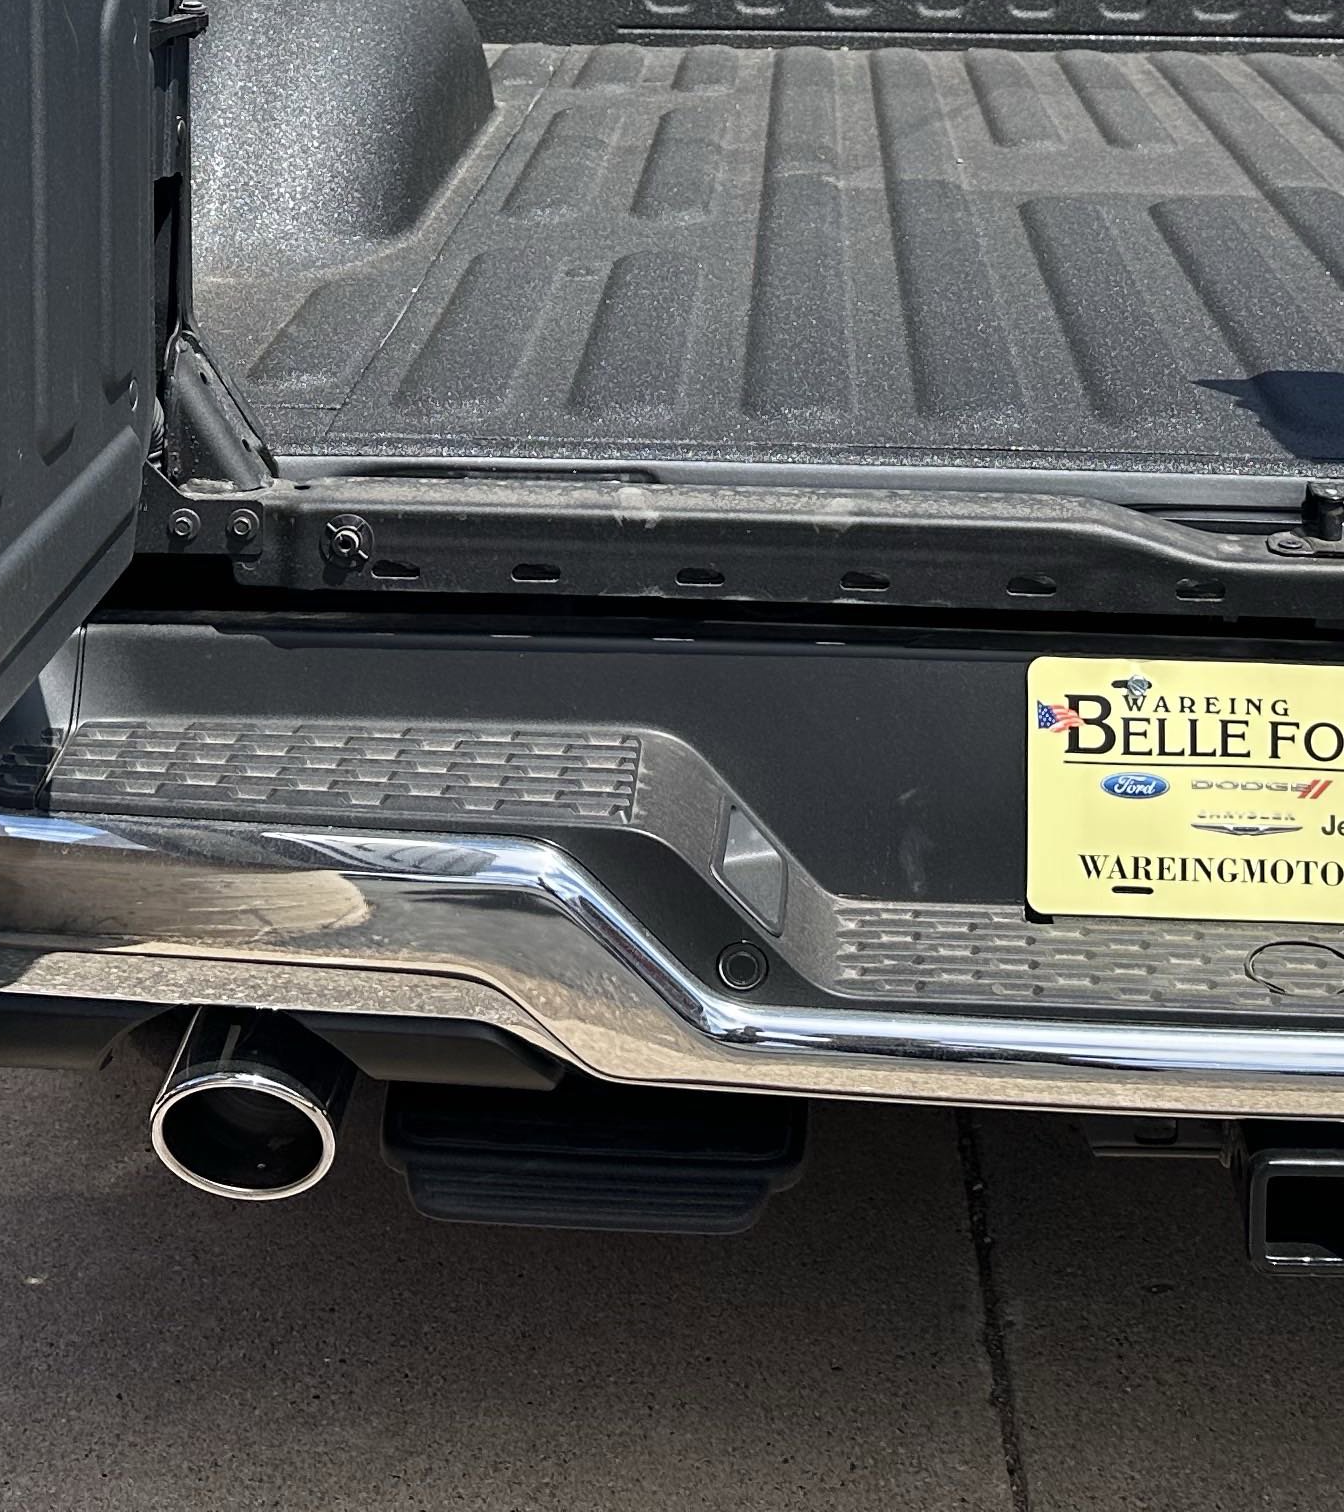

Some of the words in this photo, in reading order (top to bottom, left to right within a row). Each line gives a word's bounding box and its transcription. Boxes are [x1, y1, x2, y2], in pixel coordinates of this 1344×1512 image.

[1124, 694, 1291, 718] WAREING
[1064, 693, 1251, 759] BELLE
[1190, 779, 1312, 793] DODGE
